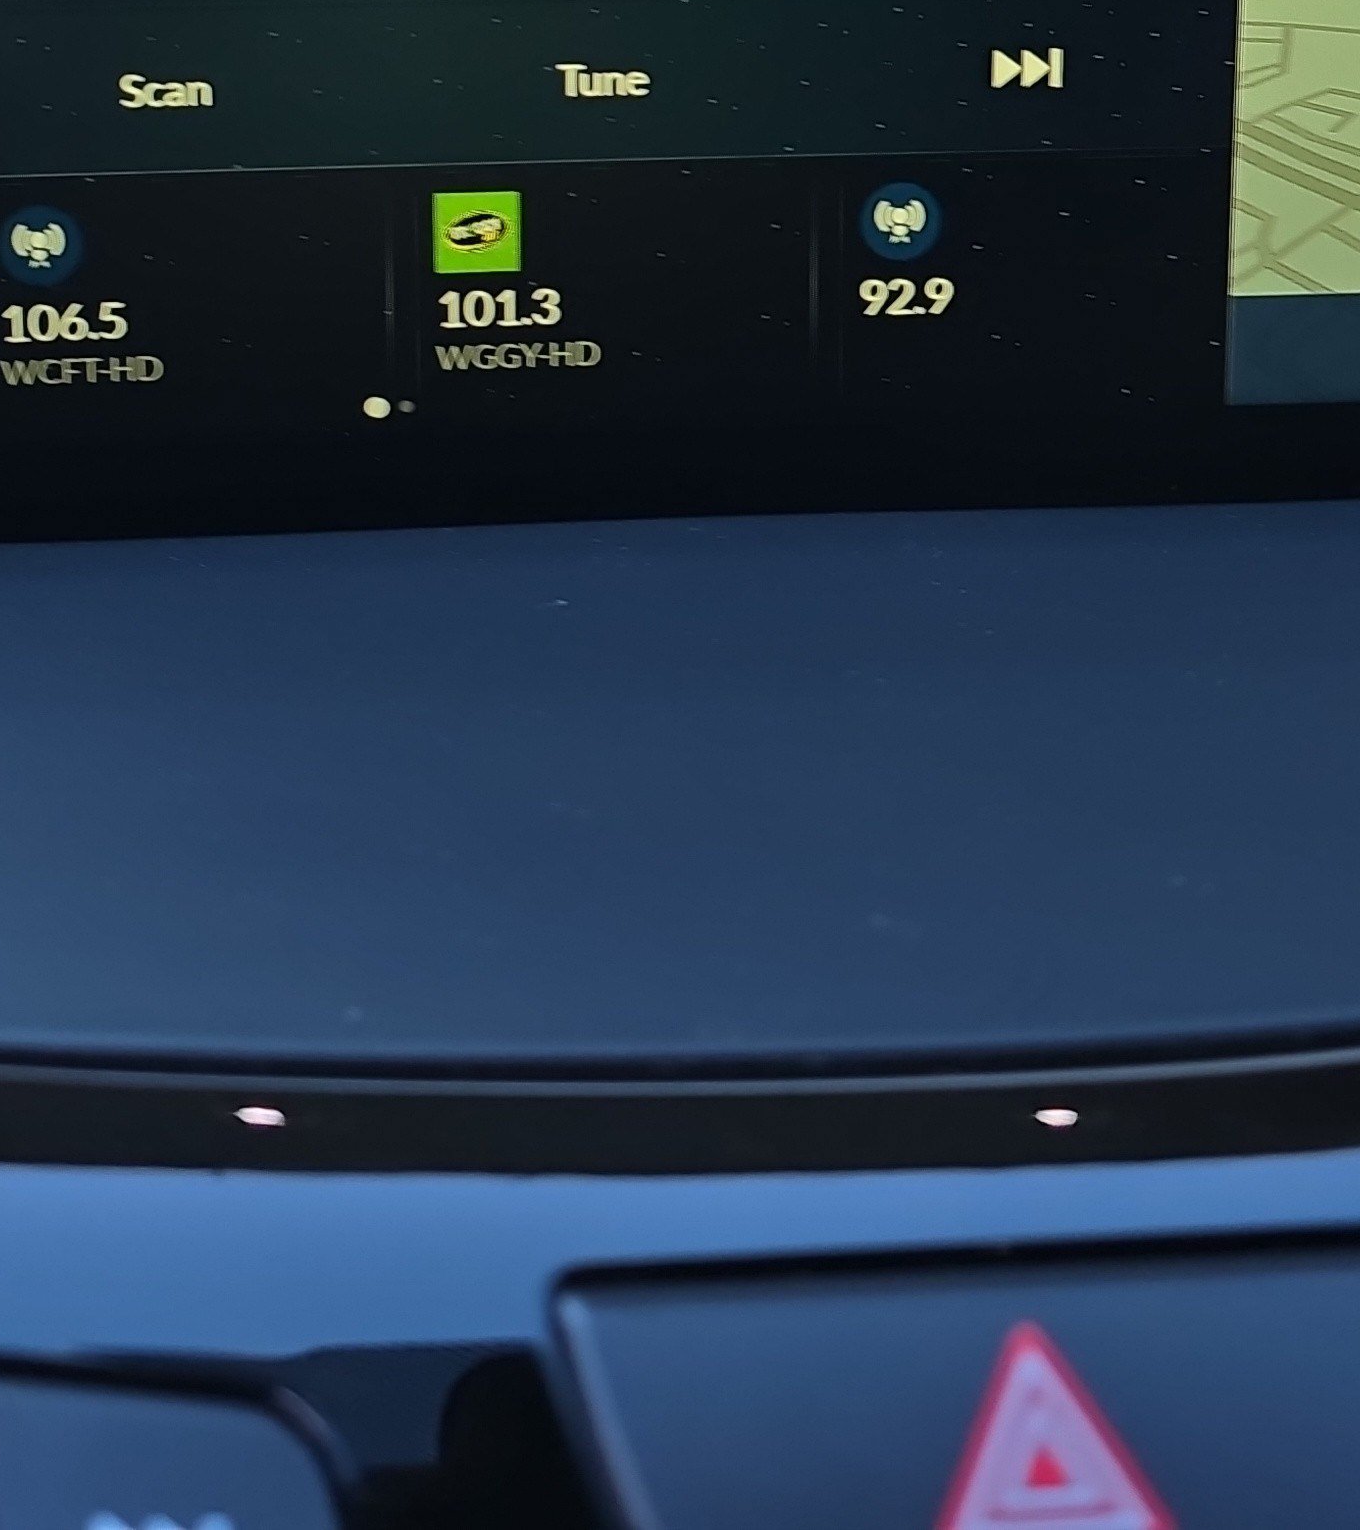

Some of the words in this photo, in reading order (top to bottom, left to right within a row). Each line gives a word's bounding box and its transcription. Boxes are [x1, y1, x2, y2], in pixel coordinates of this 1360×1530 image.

[118, 73, 214, 109] Scan
[554, 63, 651, 98] Tune
[438, 287, 562, 329] 101.3
[859, 277, 955, 316] 92.9
[0, 301, 129, 344] 106.5
